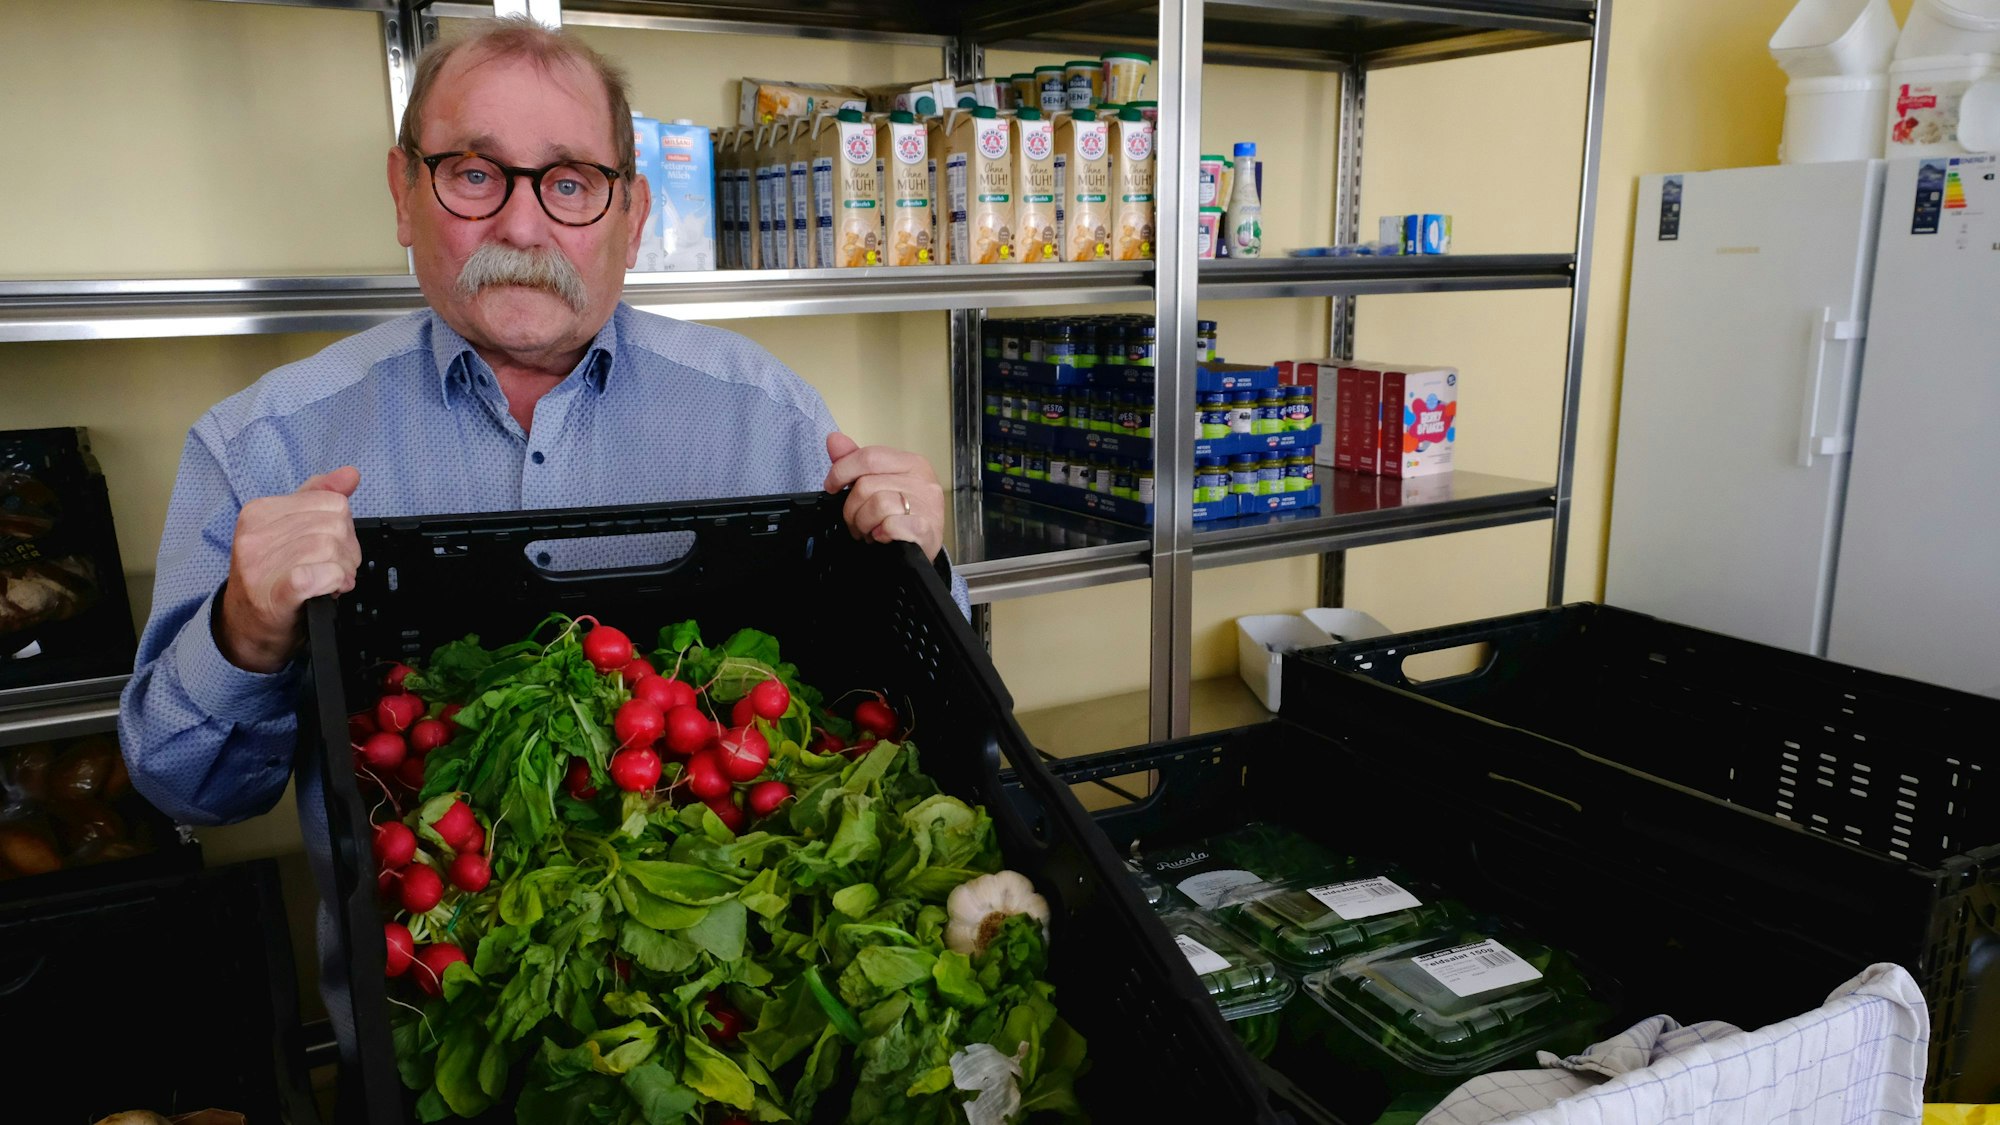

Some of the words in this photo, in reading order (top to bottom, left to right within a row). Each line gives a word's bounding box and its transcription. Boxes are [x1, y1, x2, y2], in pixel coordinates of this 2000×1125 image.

[1042, 95, 1065, 104] SENF
[984, 162, 1003, 173] Ohne
[1029, 163, 1047, 174] Ohne
[1083, 164, 1101, 173] Ohne
[1130, 164, 1147, 174] Ohne
[667, 171, 690, 179] Milch
[850, 168, 869, 178] Ohne
[902, 168, 922, 178] Ohne
[980, 174, 1008, 185] MUH!
[1024, 175, 1052, 186] MUH!
[1078, 175, 1105, 186] MUH!
[1124, 174, 1152, 186] MUH!
[845, 180, 874, 191] MUH!
[897, 179, 926, 191] MUH!
[1043, 404, 1064, 413] PESTO
[1287, 404, 1310, 414] PESTO
[1156, 852, 1209, 871] Rucola
[1470, 947, 1495, 956] 150g
